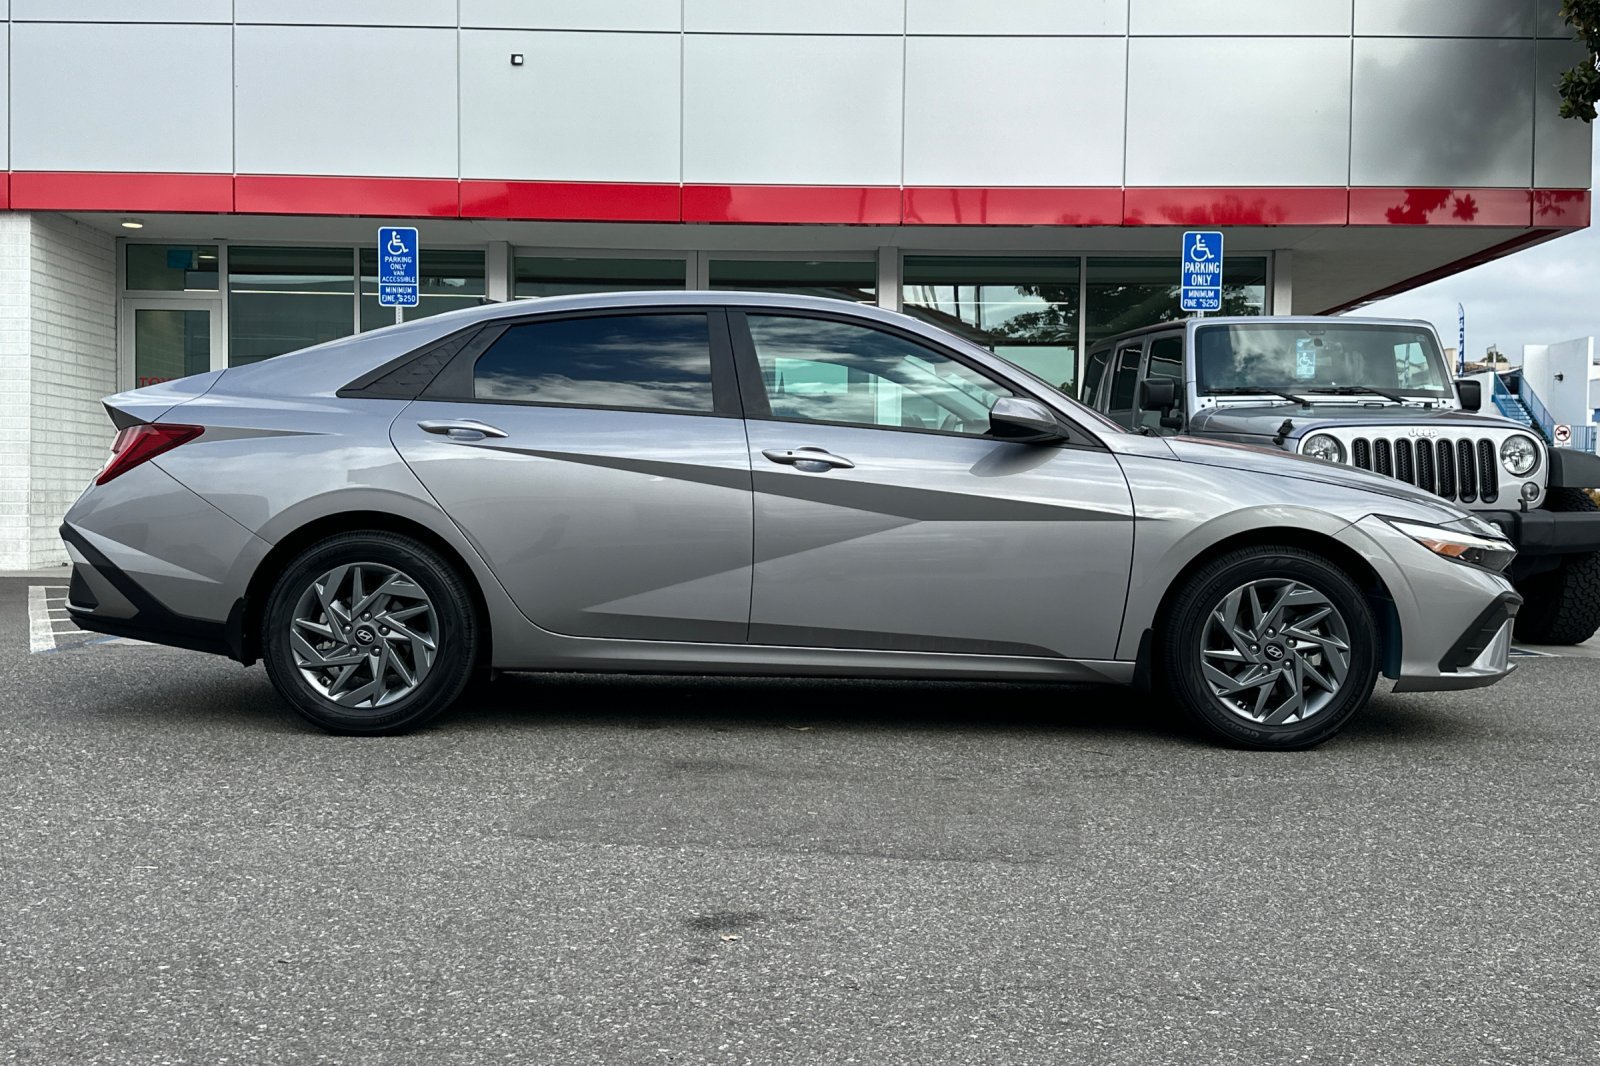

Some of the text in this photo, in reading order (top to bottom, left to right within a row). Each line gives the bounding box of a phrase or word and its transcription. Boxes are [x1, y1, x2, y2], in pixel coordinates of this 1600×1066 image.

[1185, 262, 1219, 273] PARKING
[1191, 274, 1212, 286] ONLY
[1188, 290, 1214, 298] MINIMUM
[1184, 299, 1218, 307] FINE $250
[1408, 428, 1437, 438] Jeep
